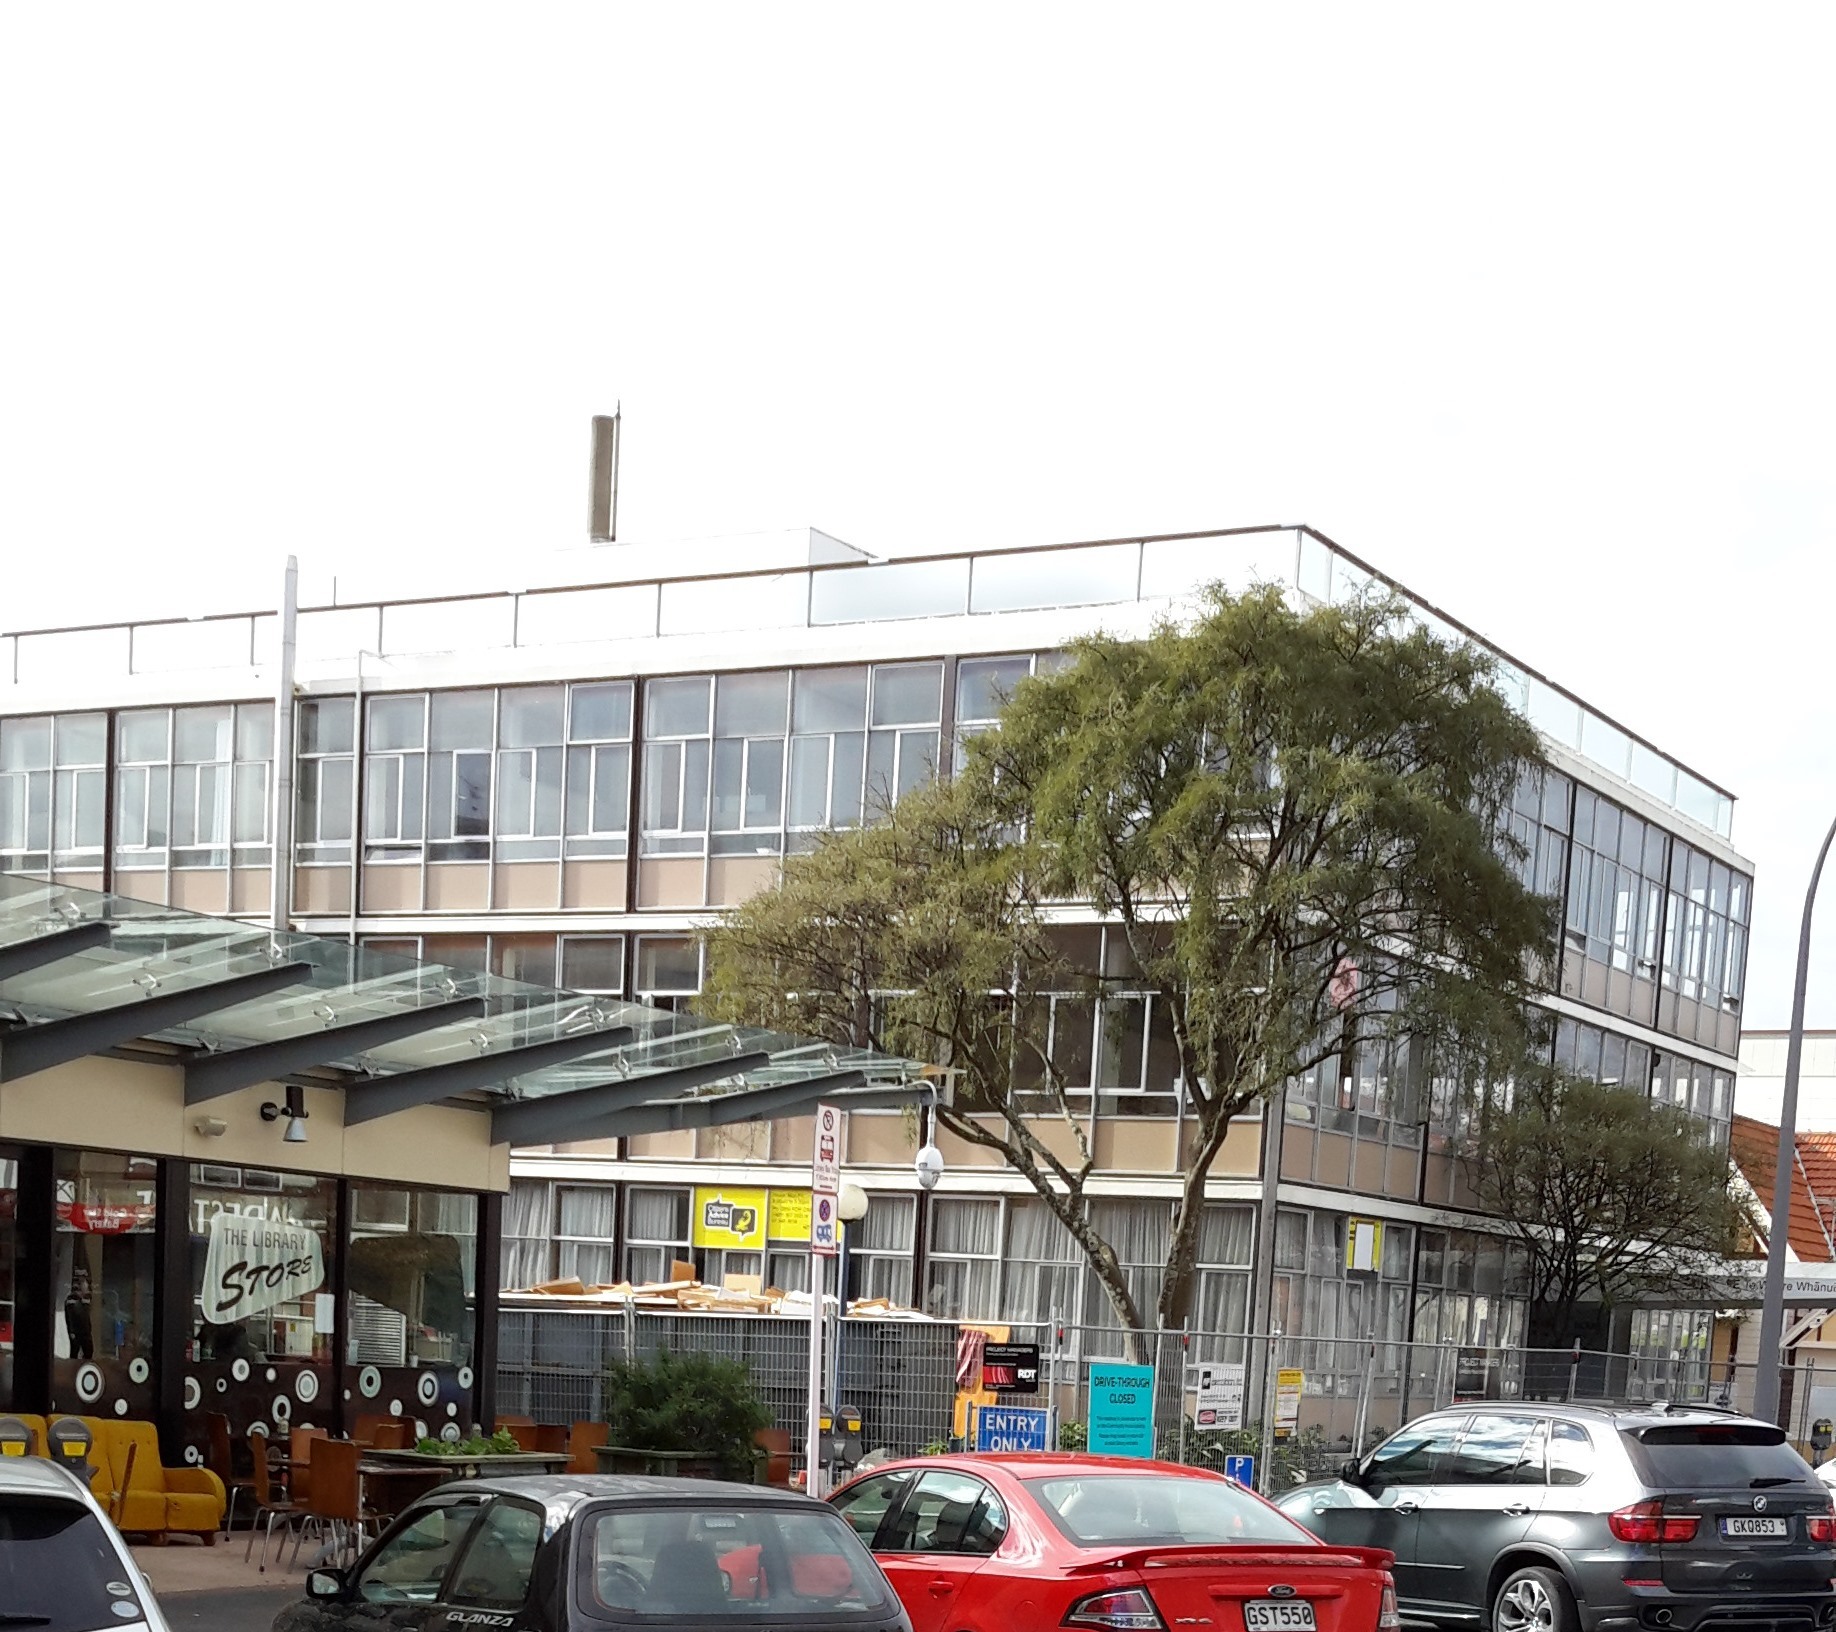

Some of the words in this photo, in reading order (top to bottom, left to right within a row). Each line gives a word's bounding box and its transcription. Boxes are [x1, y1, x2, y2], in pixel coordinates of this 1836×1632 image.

[224, 1228, 247, 1246] THE
[252, 1230, 306, 1251] LIBRARY
[1017, 1368, 1037, 1380] RDT
[1094, 1376, 1150, 1389] DRIVE-THROUGH
[1109, 1393, 1137, 1405] CLOSED
[985, 1414, 1040, 1432] ENTRY
[990, 1435, 1032, 1452] ONLY
[1234, 1457, 1245, 1472] P
[1733, 1519, 1775, 1534] GKQ853
[445, 1611, 515, 1627] GLANZA
[1246, 1606, 1313, 1625] GST550
